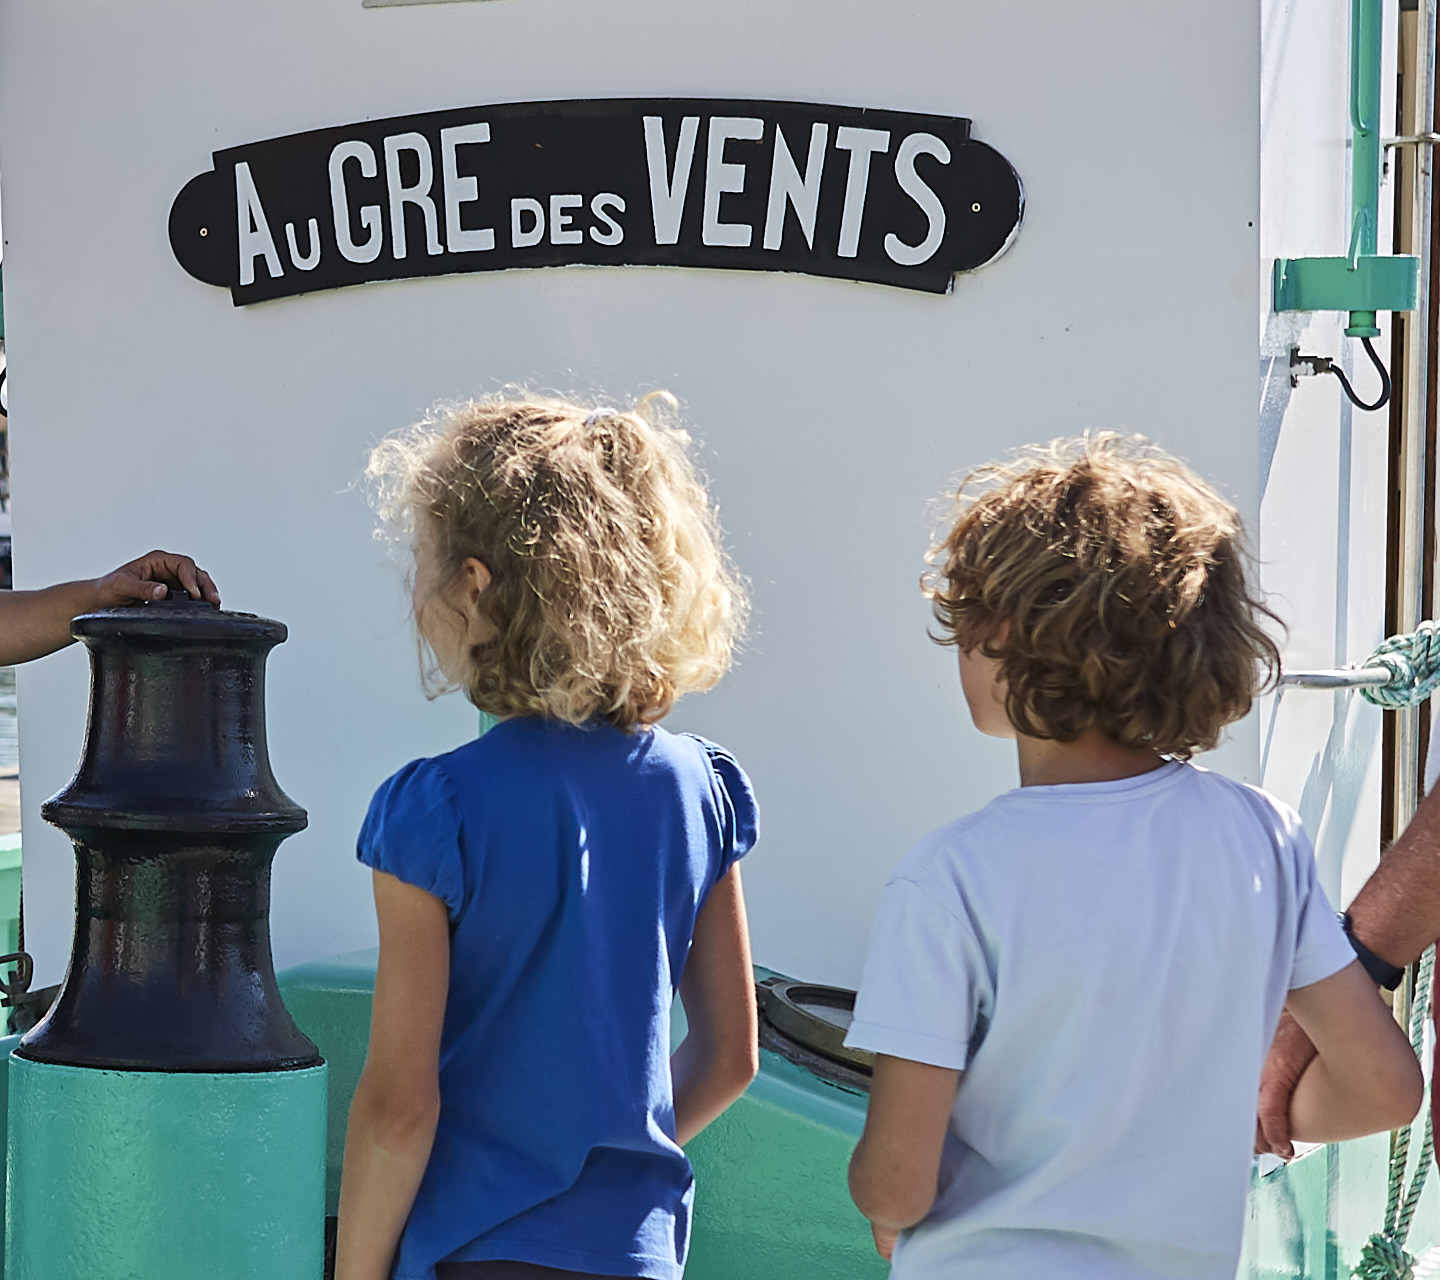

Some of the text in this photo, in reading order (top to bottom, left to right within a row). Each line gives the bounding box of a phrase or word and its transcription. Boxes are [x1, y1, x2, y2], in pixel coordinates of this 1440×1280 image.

[327, 122, 495, 264] GRE
[510, 192, 626, 249] DES
[642, 115, 952, 267] VENTS
